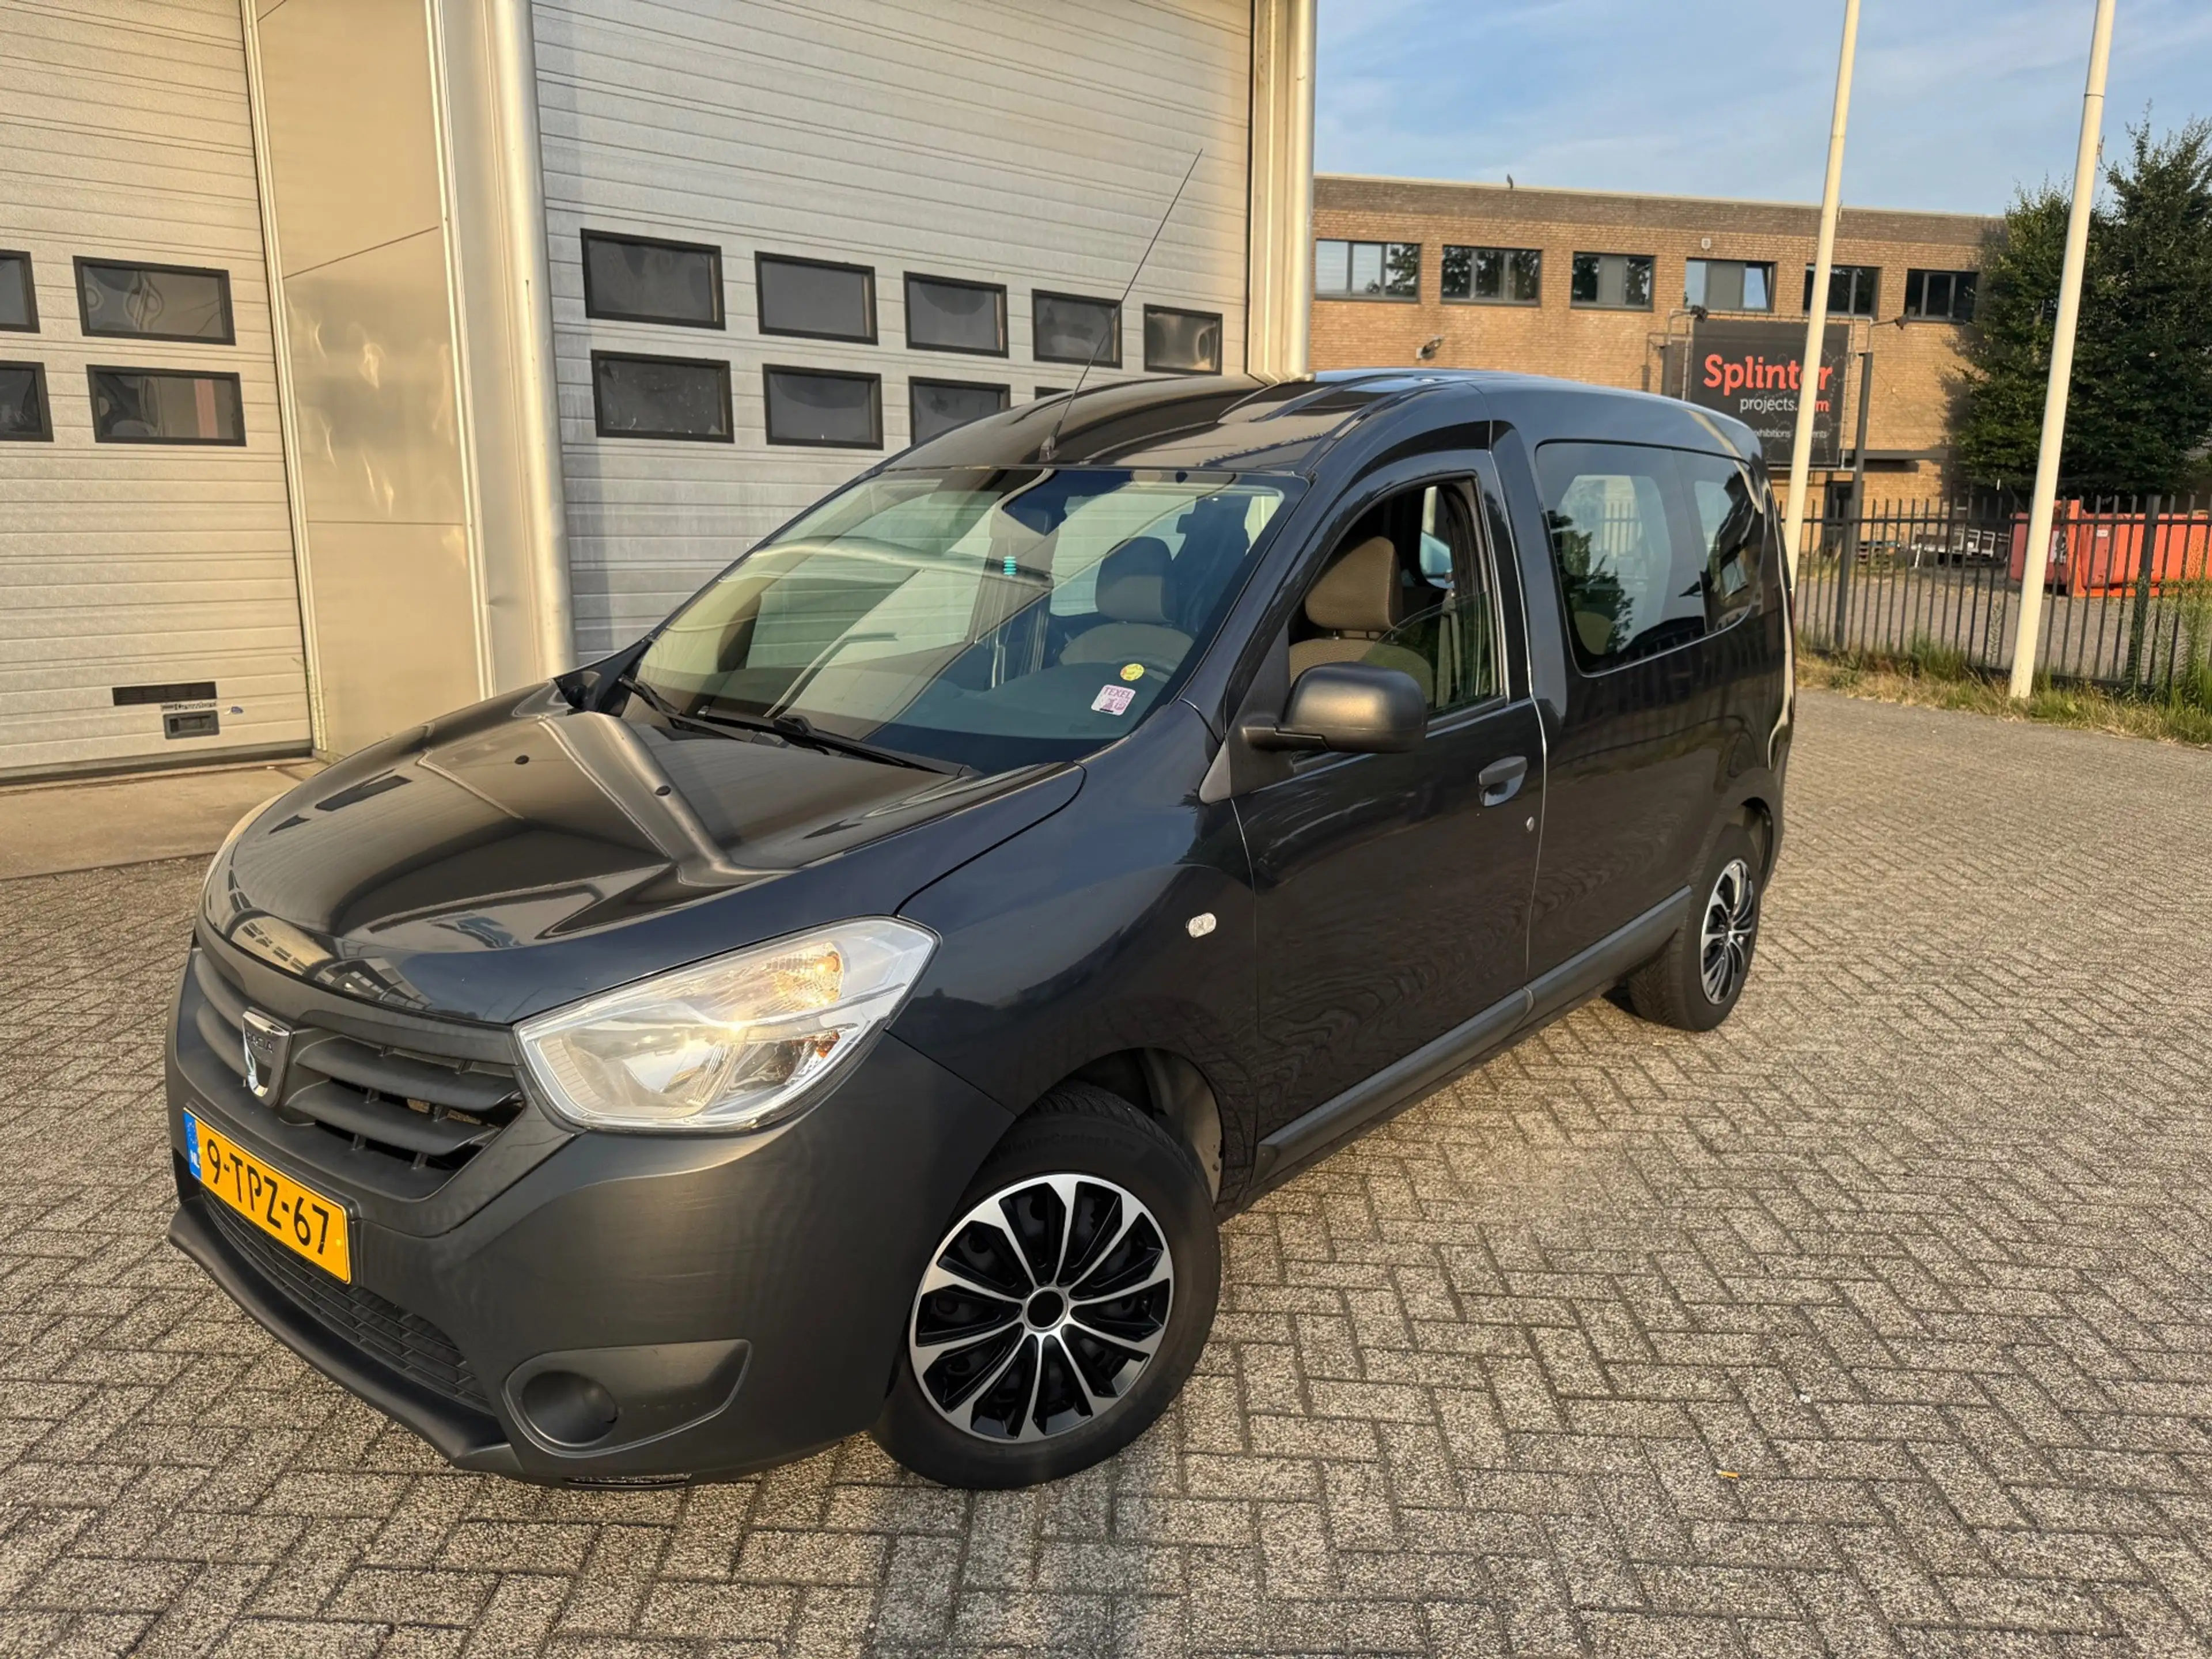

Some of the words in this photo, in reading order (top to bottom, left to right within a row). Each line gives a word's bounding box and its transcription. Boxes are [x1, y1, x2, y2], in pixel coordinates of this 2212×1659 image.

[1703, 354, 1834, 396] Splintr
[1740, 396, 1830, 414] projects.m
[1753, 427, 1791, 438] xhibitions
[1104, 686, 1131, 699] TEXEL
[190, 1149, 200, 1169] NL
[207, 1138, 329, 1255] 9-TPZ-67
